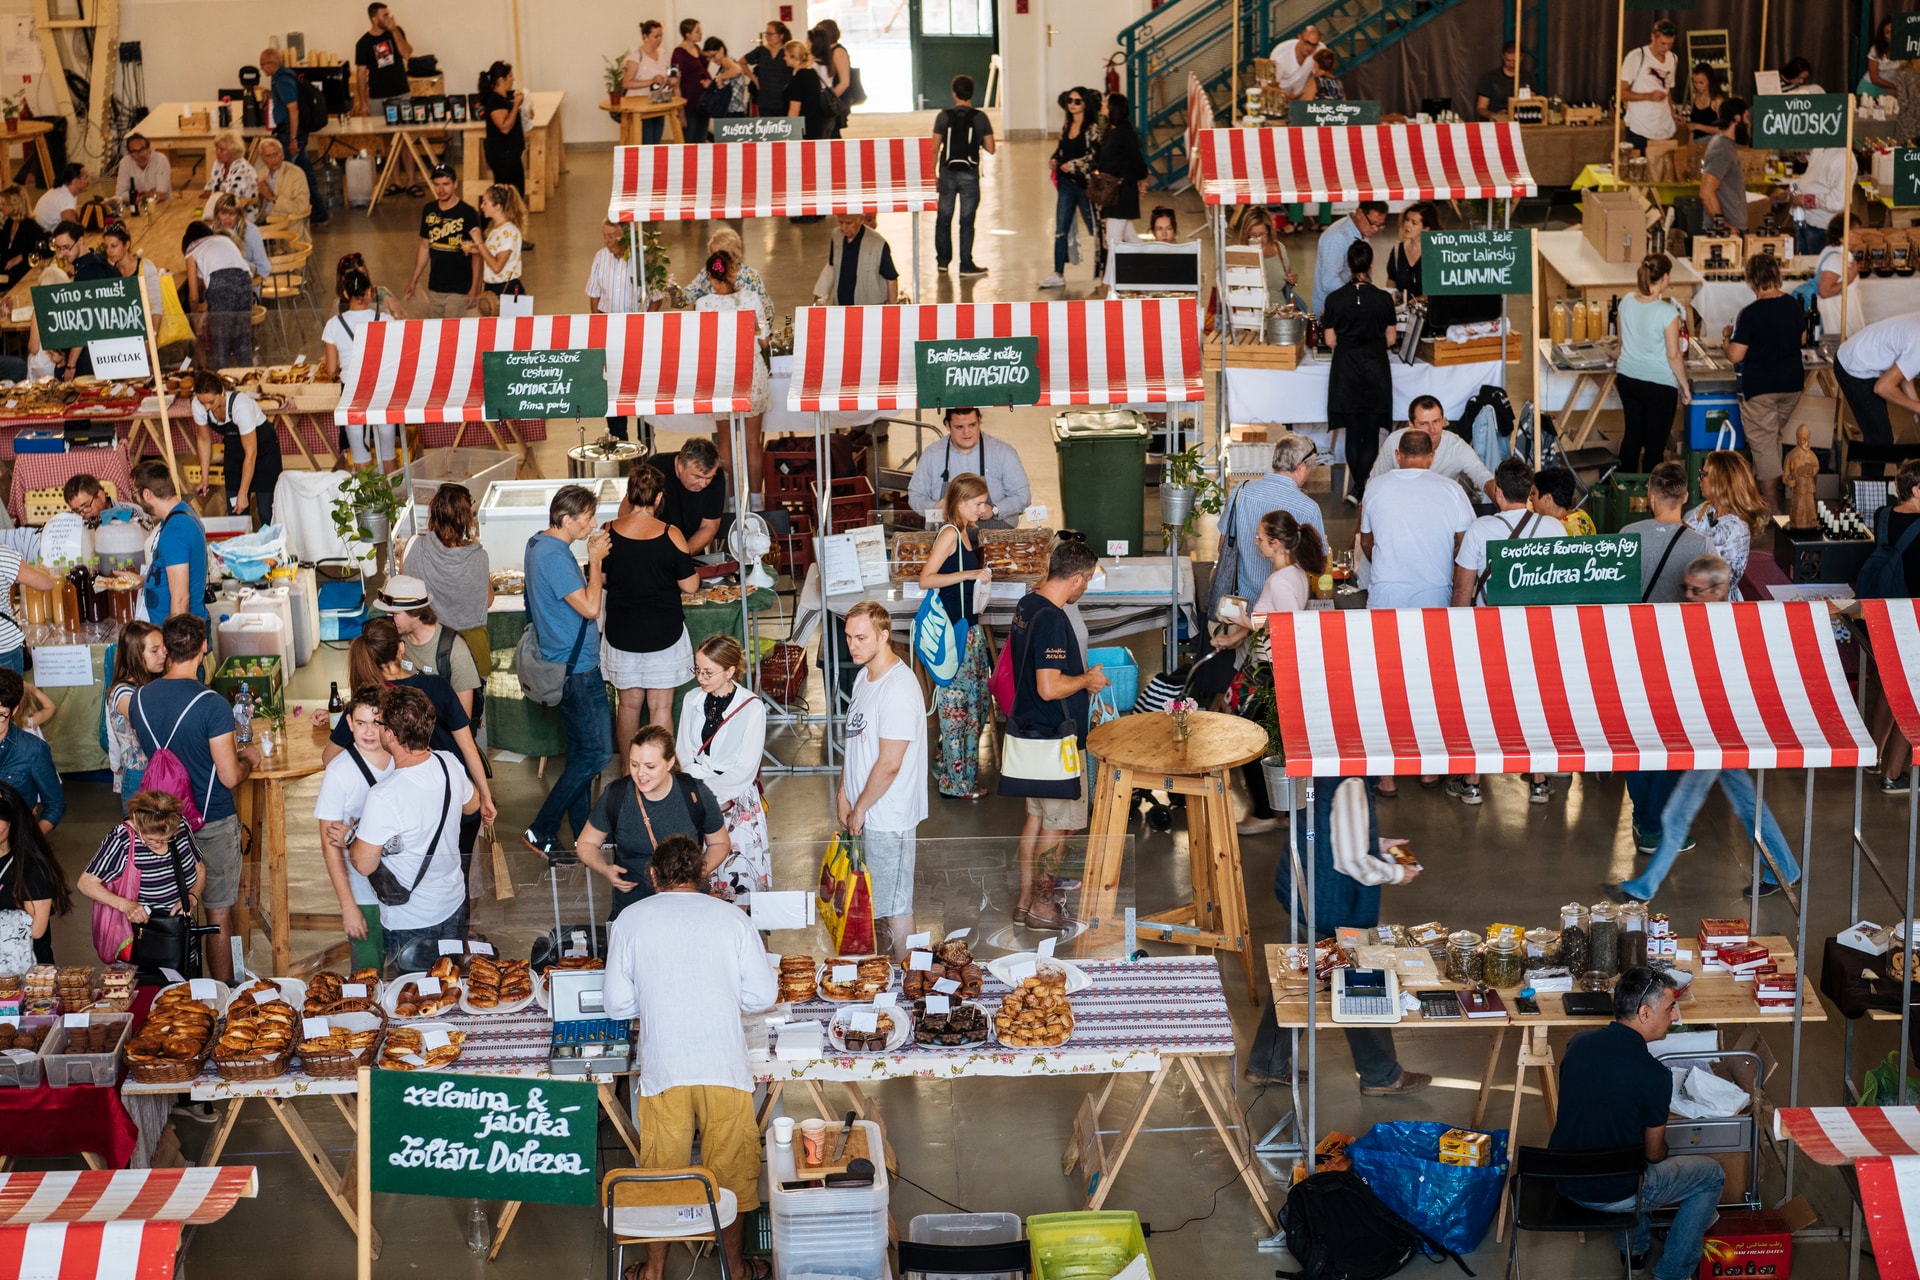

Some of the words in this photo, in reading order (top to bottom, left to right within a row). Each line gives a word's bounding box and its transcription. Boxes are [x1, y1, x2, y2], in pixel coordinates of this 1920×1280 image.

[721, 122, 754, 136] sušené
[755, 119, 792, 139] bylinky
[1762, 104, 1843, 135] ČAVOJSKÝ
[1440, 250, 1472, 264] Tibor
[1440, 267, 1512, 286] LALINWINE
[51, 288, 81, 304] víno
[95, 280, 126, 299] mušt
[47, 307, 94, 333] JURAJ
[96, 352, 142, 365] BURČIAK
[506, 351, 542, 366] čerstvé
[548, 350, 581, 364] sušené
[927, 347, 992, 364] Bratislavské
[993, 345, 1023, 365] rožky
[945, 365, 1030, 387] FANTASTICO
[518, 400, 545, 412] Prima
[1500, 541, 1551, 559] exotické
[1616, 537, 1639, 558] figy
[403, 1081, 522, 1112] zelenina
[526, 1087, 549, 1112] &
[473, 1105, 582, 1139] jablká
[388, 1135, 485, 1171] Zoltán
